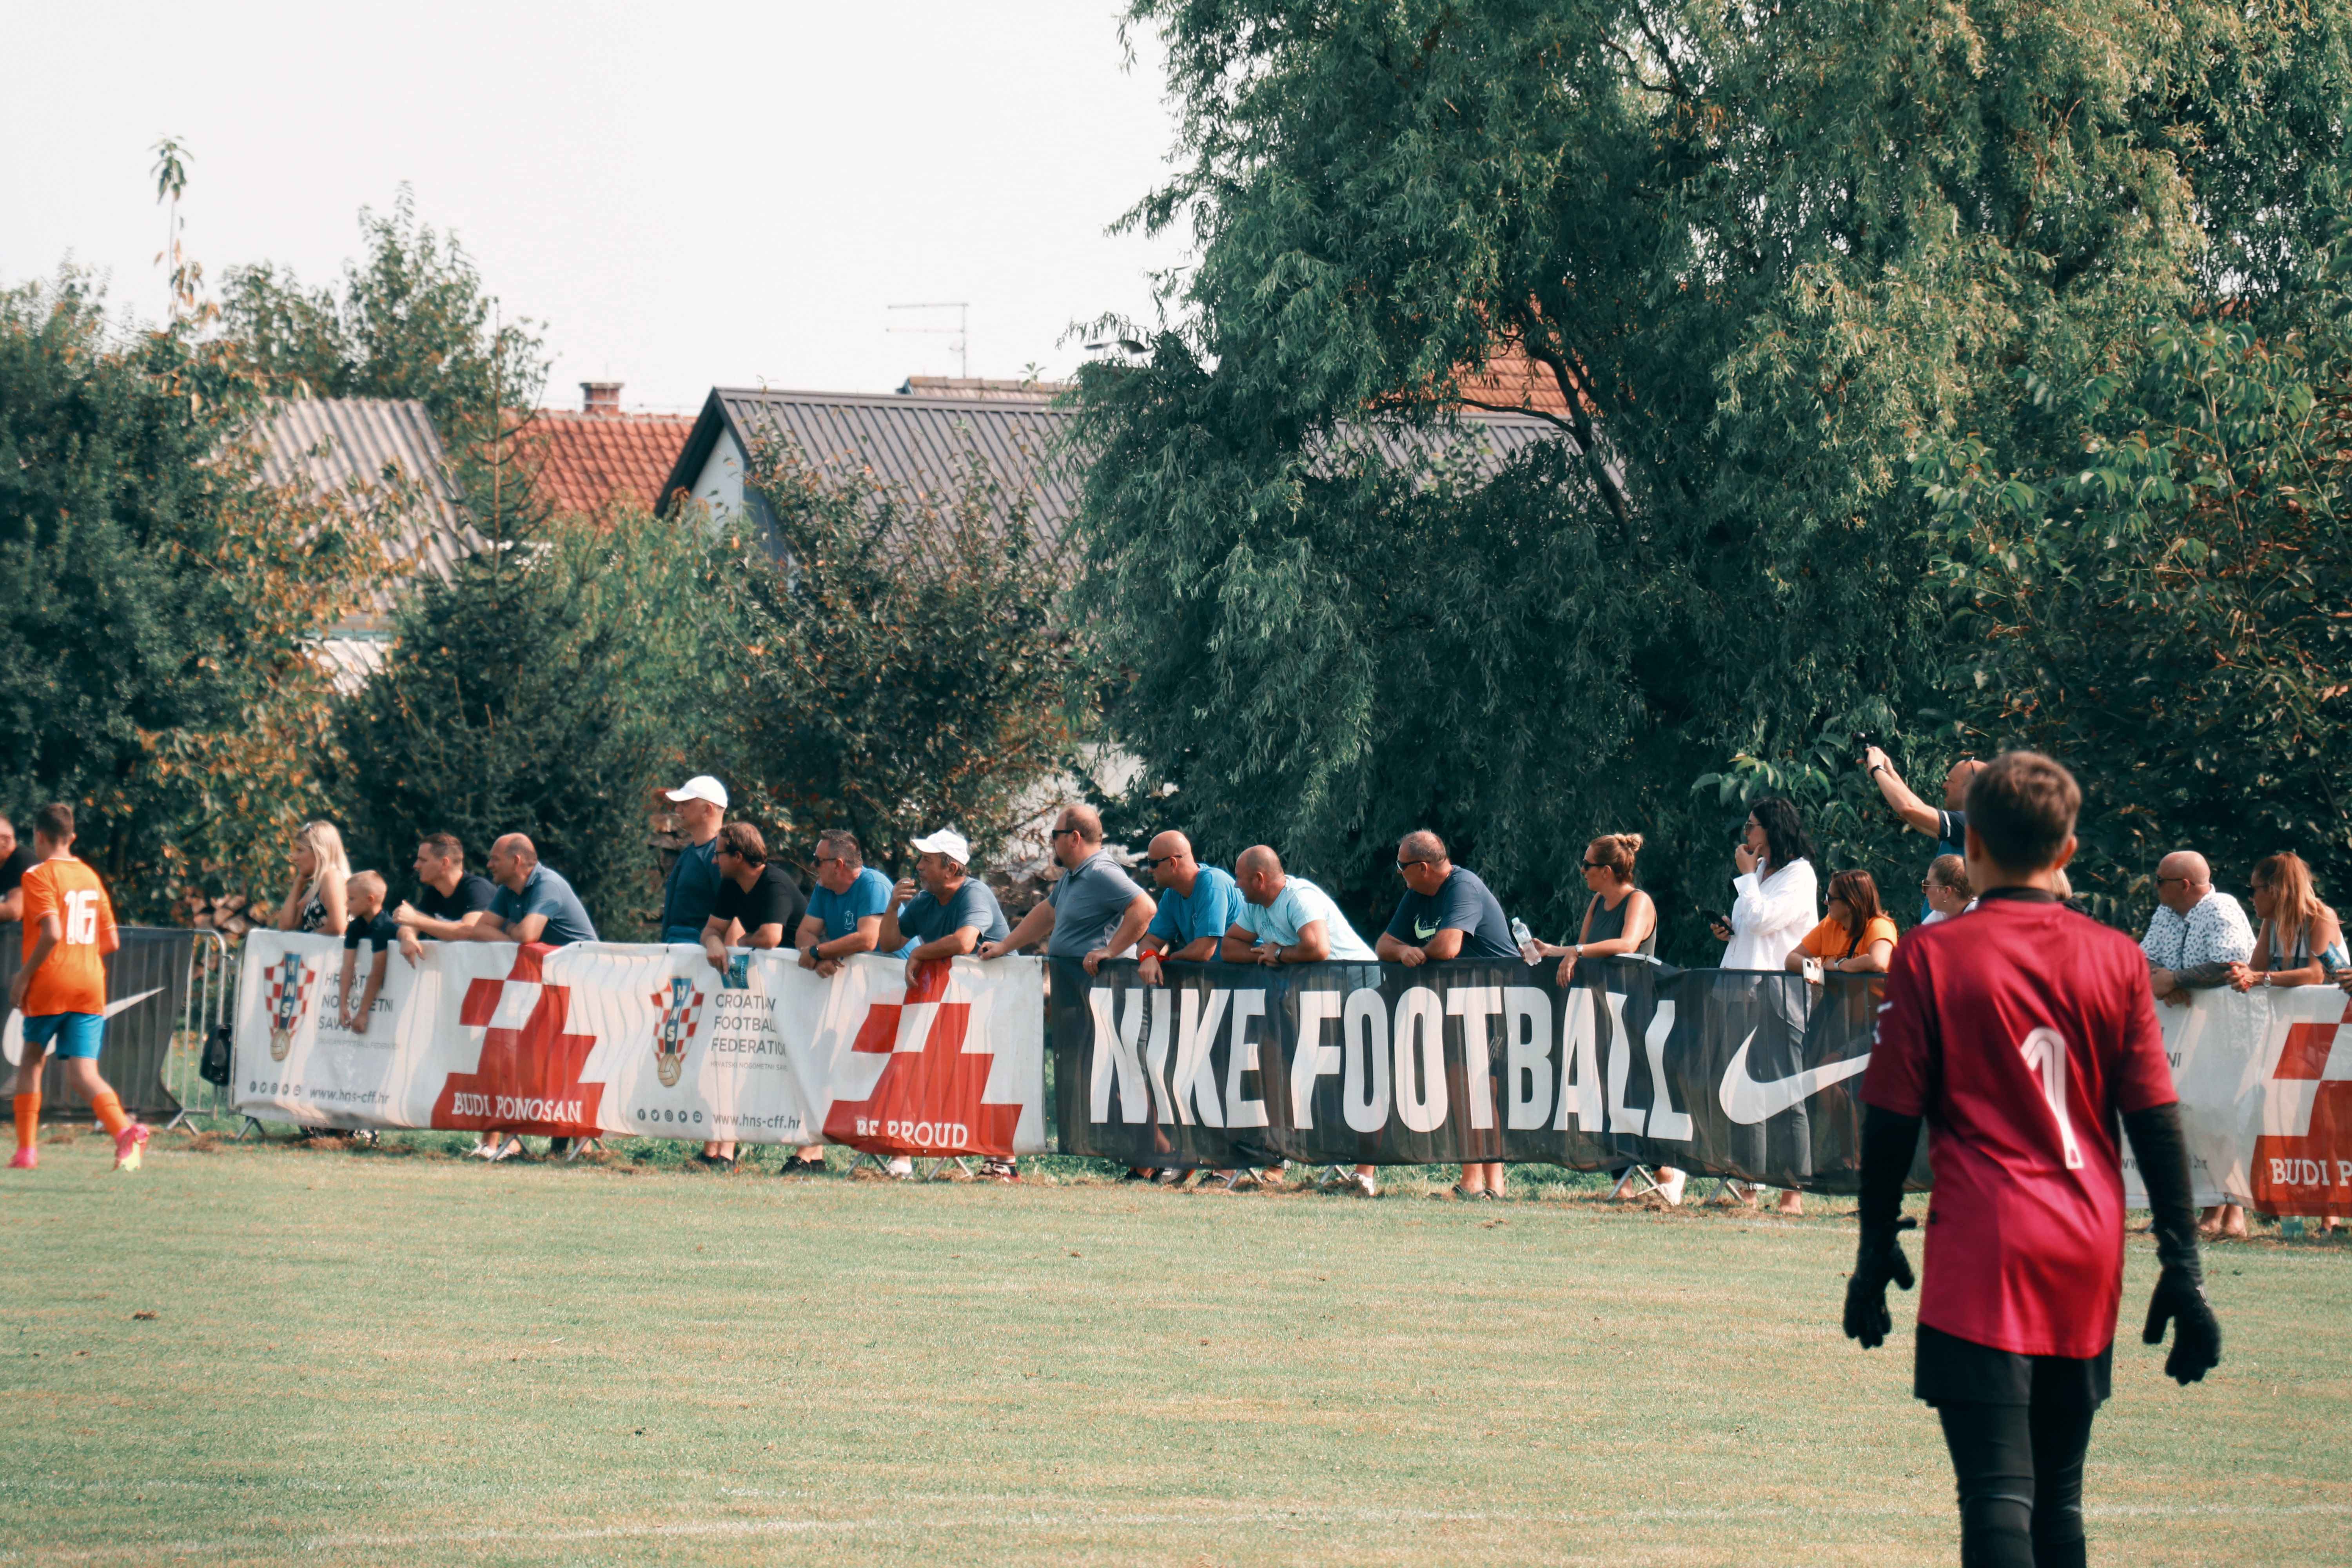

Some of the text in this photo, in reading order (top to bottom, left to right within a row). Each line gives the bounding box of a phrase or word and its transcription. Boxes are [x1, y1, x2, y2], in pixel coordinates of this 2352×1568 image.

[64, 890, 98, 945] 16
[281, 961, 296, 1018] HNS
[321, 995, 394, 1012] NOOETNI
[667, 985, 686, 1042] HNS
[714, 1016, 777, 1033] FOOTBAL
[739, 1062, 774, 1071] NOGOMETNI
[1089, 986, 1693, 1142] NIKE FOOTBALL
[310, 1089, 389, 1104] www.hns-cff.hr
[452, 1092, 582, 1123] BUDI PONOSAN
[2020, 1027, 2084, 1170] 1
[713, 1113, 801, 1129] www.hns-cff.hr
[887, 1120, 968, 1148] PROUD
[2269, 1158, 2330, 1186] BUDI
